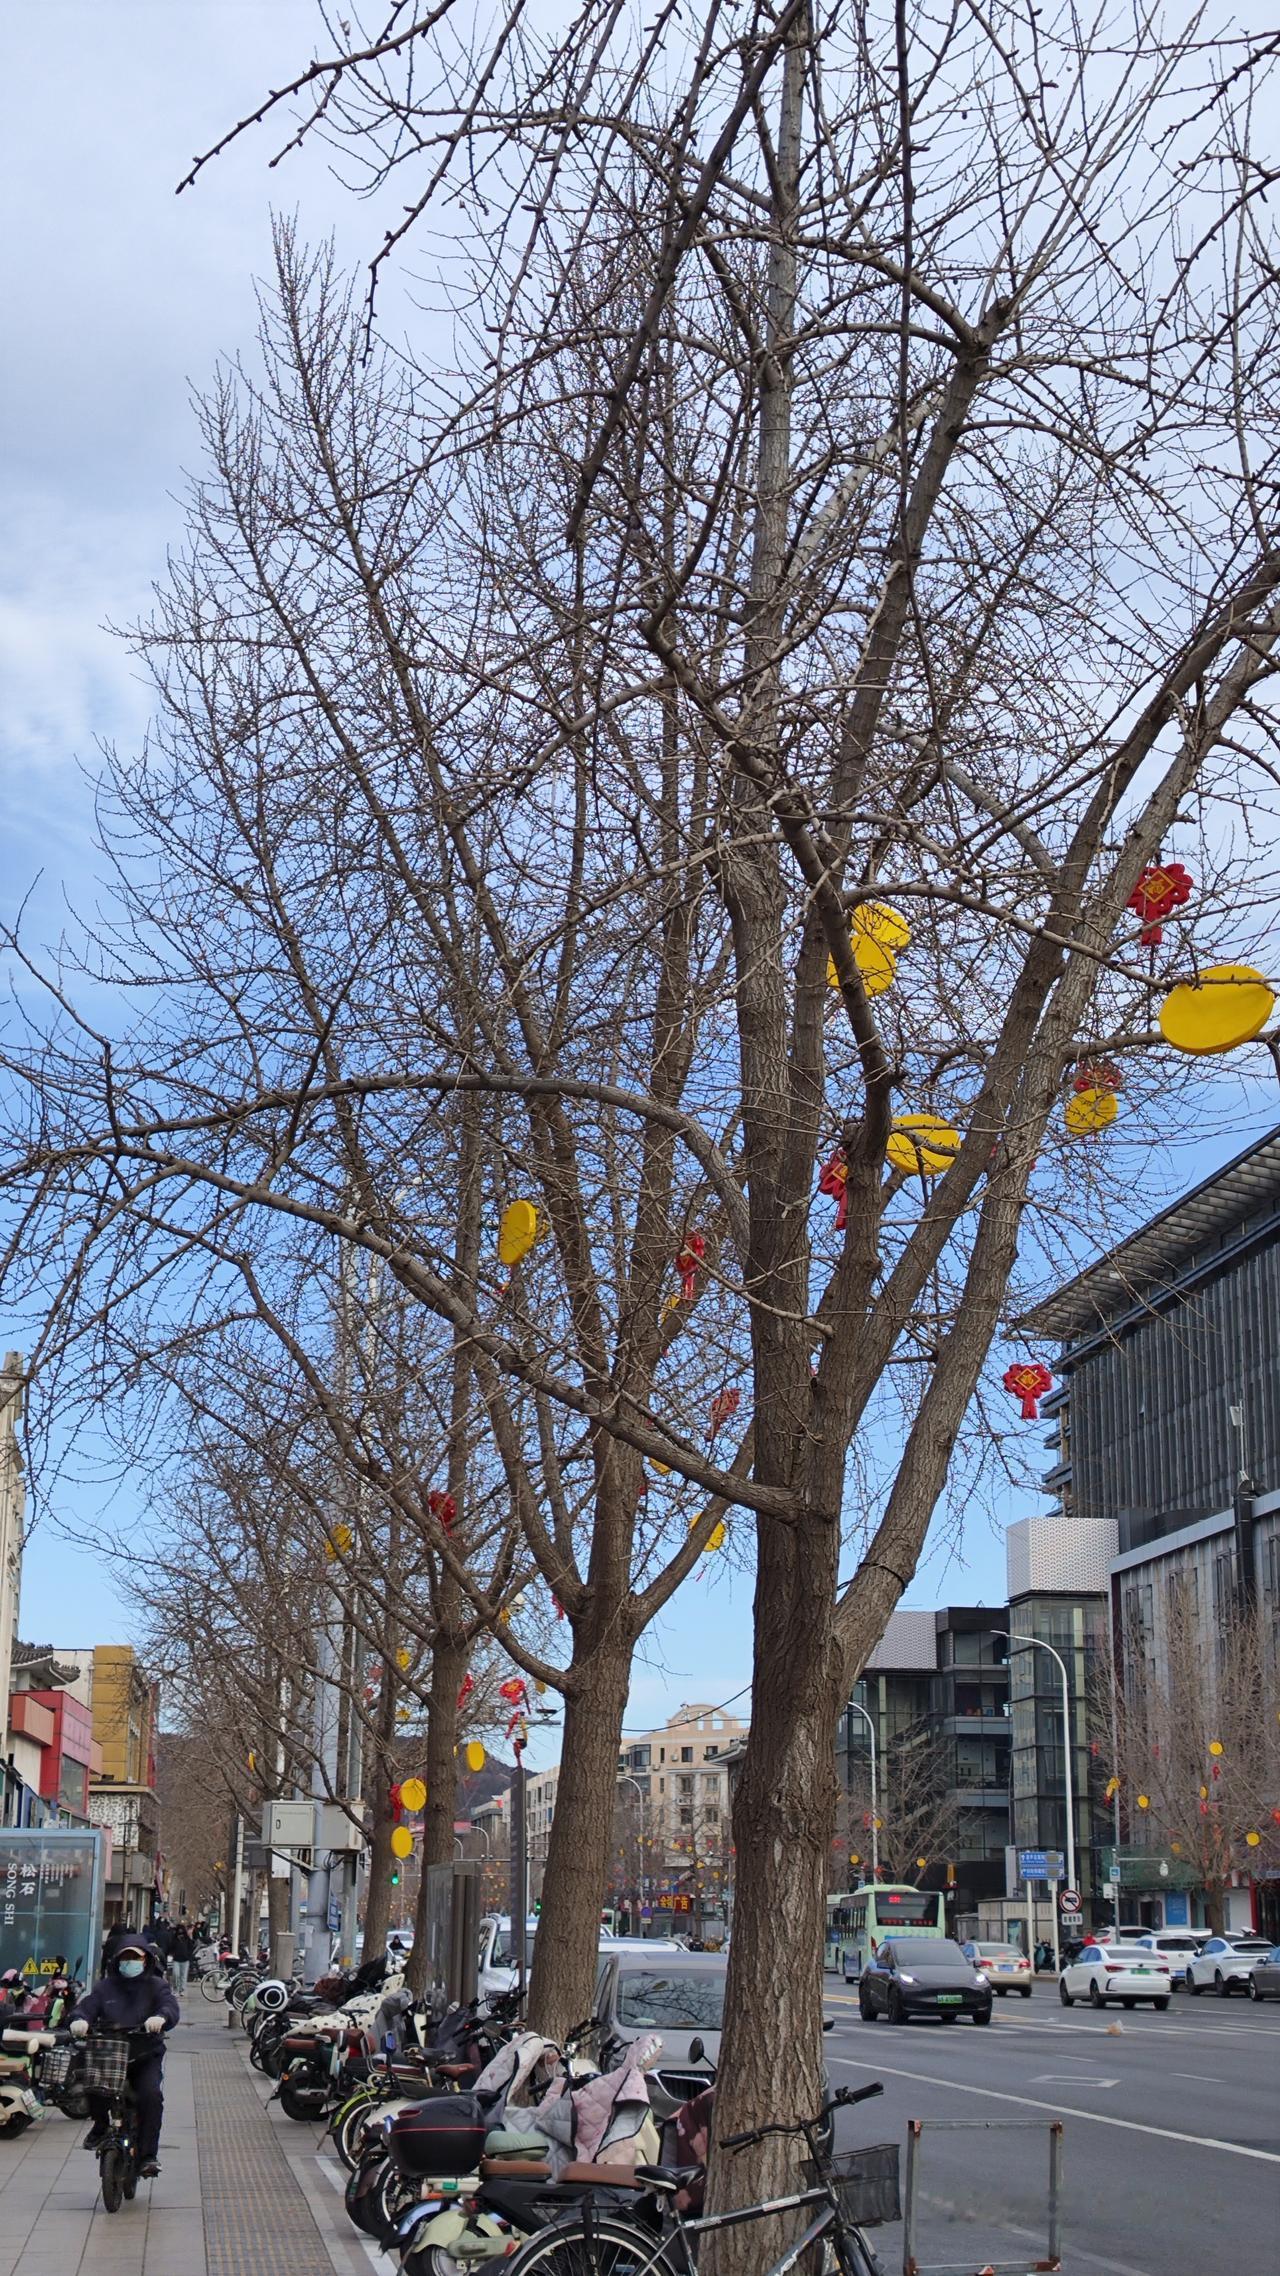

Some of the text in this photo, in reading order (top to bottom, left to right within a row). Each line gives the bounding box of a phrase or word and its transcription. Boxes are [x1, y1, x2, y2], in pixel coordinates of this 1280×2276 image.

[4, 1863, 17, 1925] SONG SHI
[19, 1863, 38, 1896] 松石
